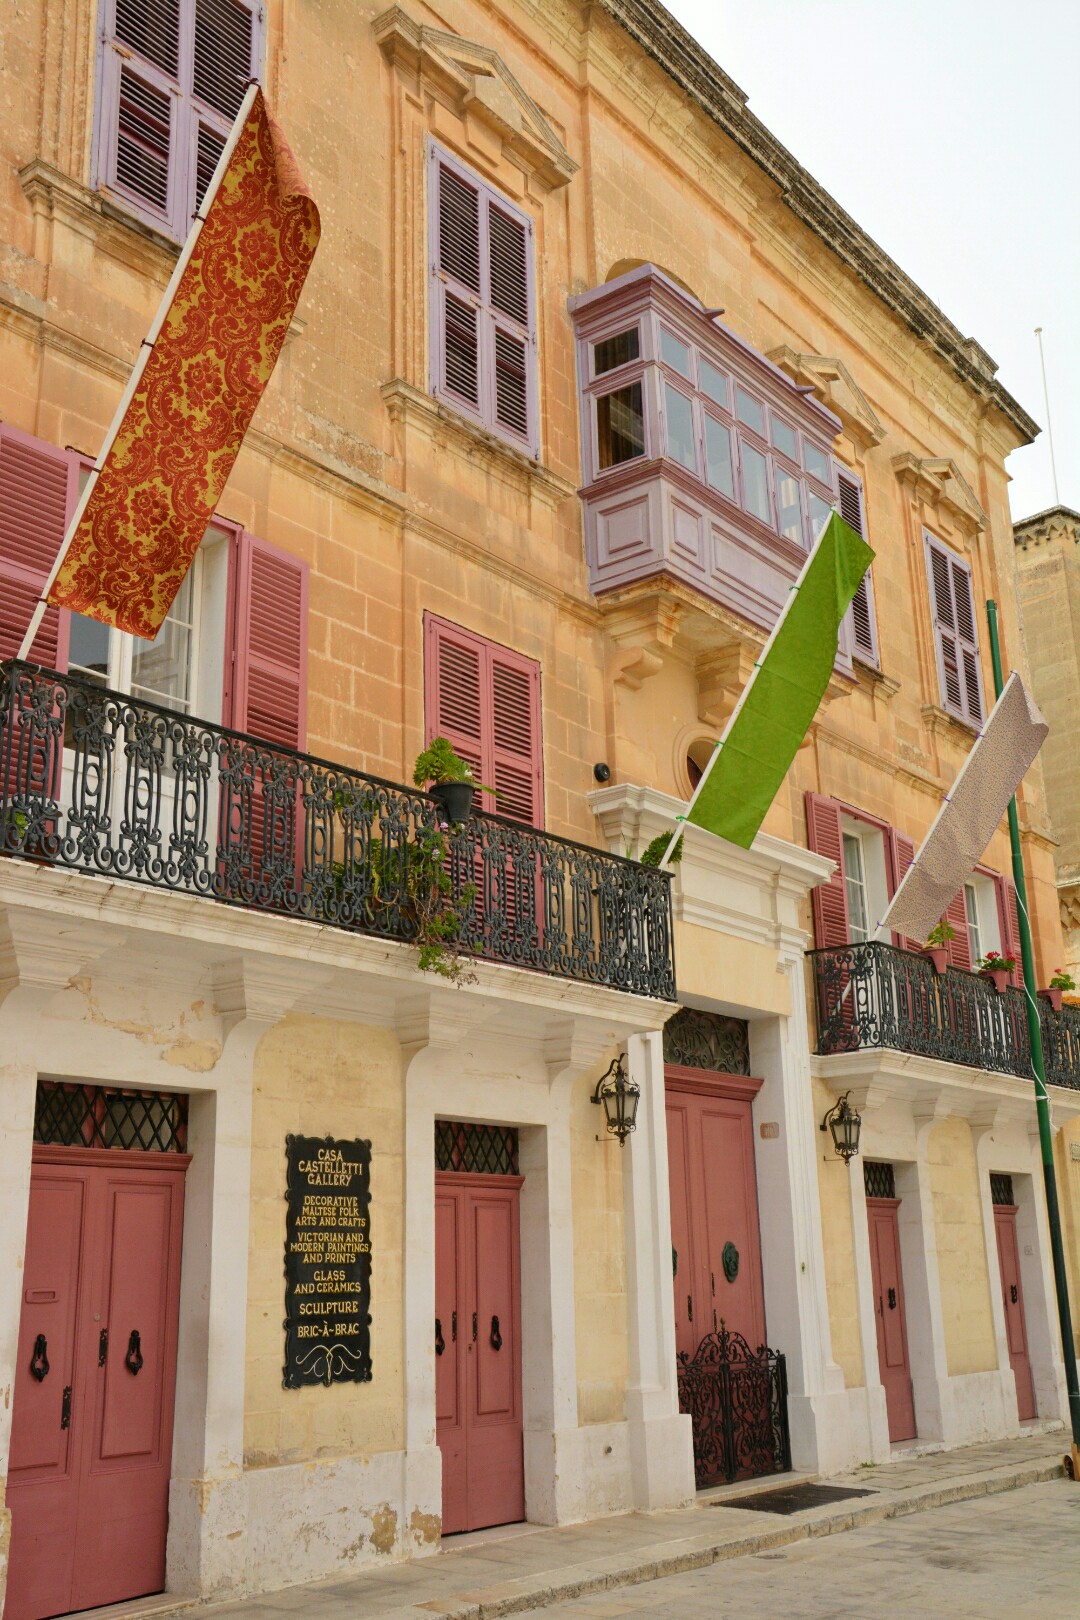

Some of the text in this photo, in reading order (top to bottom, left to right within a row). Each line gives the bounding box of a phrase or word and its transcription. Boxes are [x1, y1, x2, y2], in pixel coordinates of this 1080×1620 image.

[318, 1149, 343, 1160] CASA
[299, 1161, 363, 1175] CASTELLETTI
[308, 1173, 352, 1186] GALLERY
[304, 1195, 358, 1207] DECORATIVE
[302, 1206, 359, 1217] MALTESE FOLK
[295, 1216, 366, 1227] ARTS AND CRAFTS
[297, 1232, 364, 1243] VICTORIAN AND
[290, 1242, 369, 1252] MODERN PAINTINGS
[302, 1253, 356, 1263] AND PRINTS
[313, 1270, 346, 1281] GLASS
[294, 1282, 361, 1294] AND CERAMICS
[299, 1301, 359, 1315] SCULPTURE
